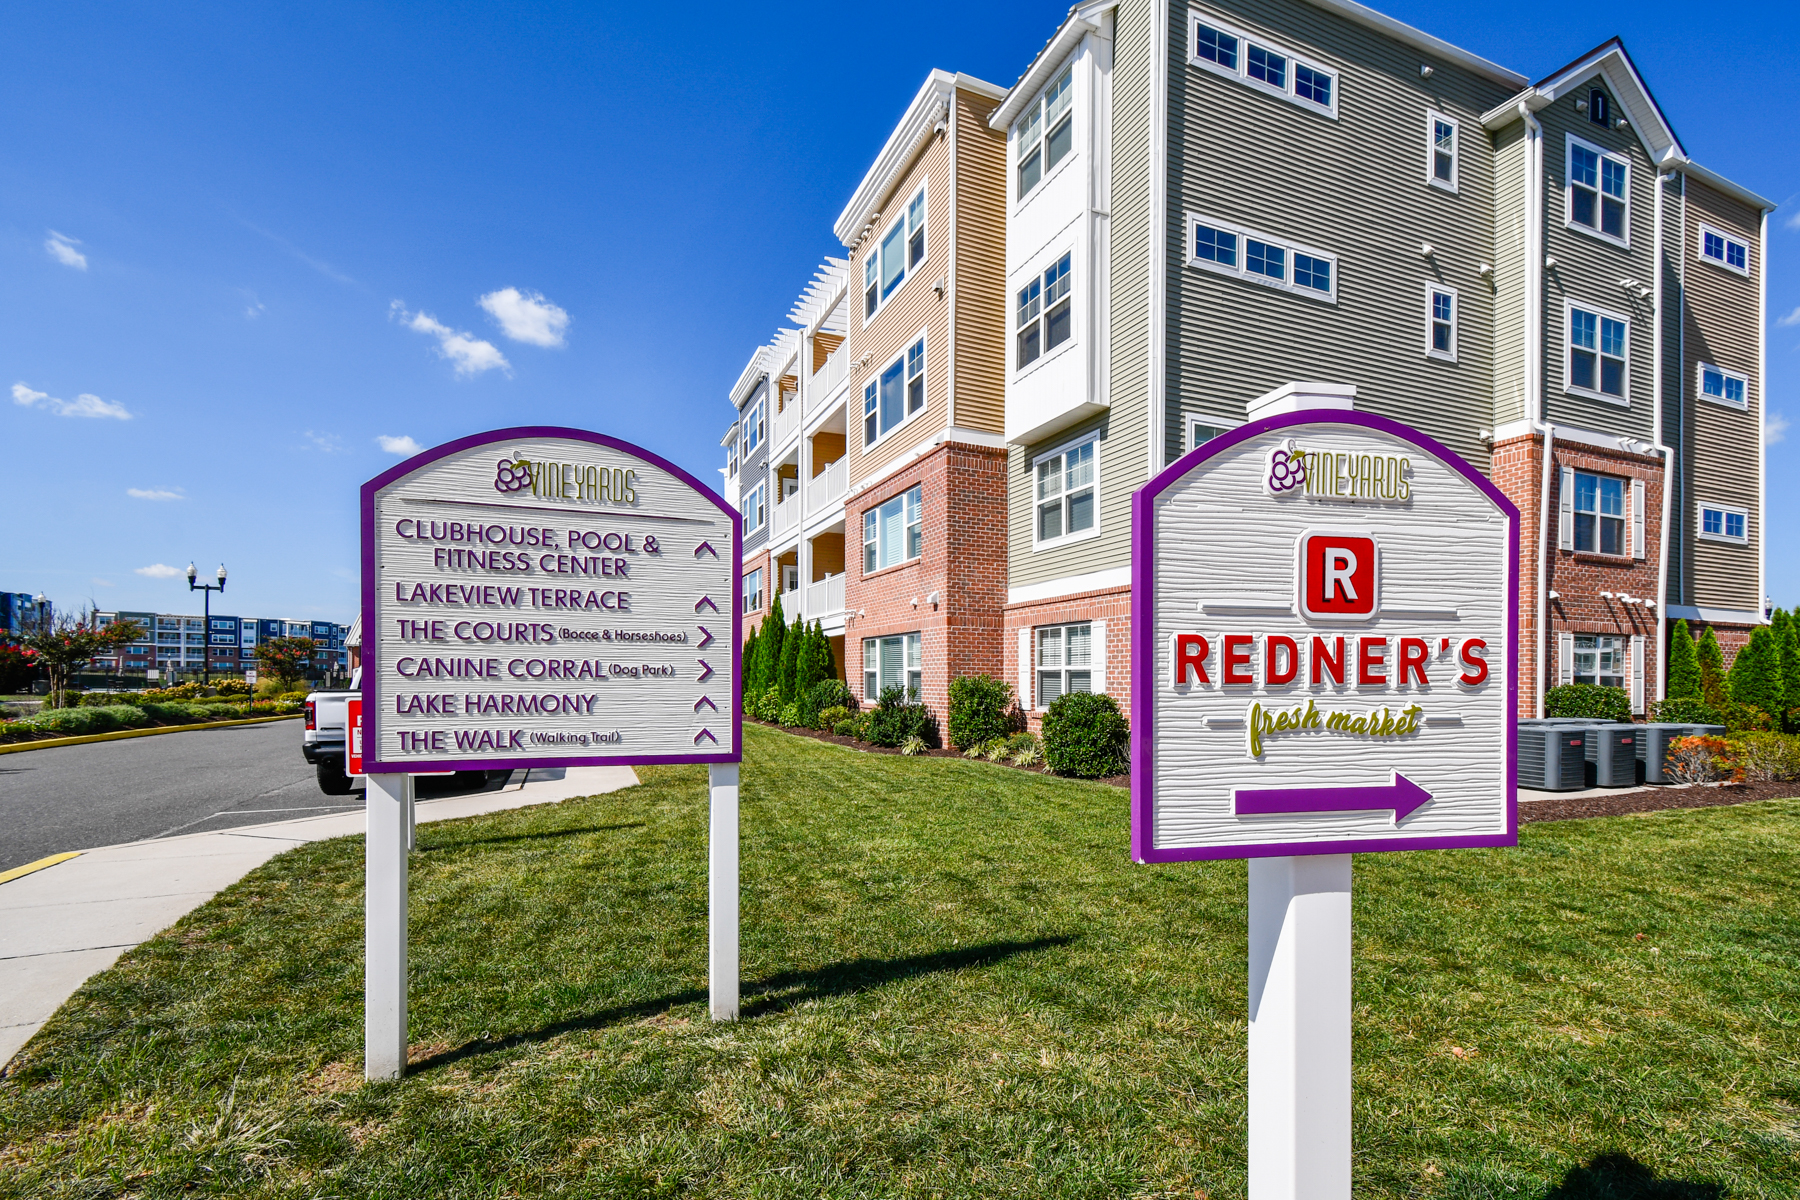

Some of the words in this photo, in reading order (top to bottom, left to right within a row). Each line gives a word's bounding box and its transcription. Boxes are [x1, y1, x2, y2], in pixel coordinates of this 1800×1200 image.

[528, 461, 636, 504] VINEYARDS
[1302, 452, 1410, 500] VINEYARDS
[395, 518, 559, 551] CLUBHOUSE,
[568, 529, 635, 553] POOL
[642, 534, 660, 554] &
[434, 547, 530, 572] FITNESS
[539, 553, 628, 576] CENTER
[1323, 546, 1359, 603] R
[395, 581, 521, 607] LAKEVIEW
[528, 587, 629, 610] TERRACE
[396, 619, 444, 640] THE
[453, 621, 554, 642] COURTS
[558, 628, 600, 641] (Bocce
[601, 629, 612, 641] &
[614, 629, 687, 643] Horseshoes)
[396, 657, 499, 678] CANINE
[507, 658, 606, 678] CORRAL
[608, 663, 639, 678] (Dog
[642, 662, 674, 676] Park)
[1176, 633, 1489, 686] REDNER'S
[395, 694, 455, 714] LAKE
[465, 694, 597, 714] HARMONY
[396, 730, 445, 751] THE
[454, 729, 523, 750] WALK
[529, 730, 586, 745] (Walking
[590, 730, 620, 744] Trail)
[1250, 699, 1321, 757] fresh
[1326, 704, 1422, 736] market
